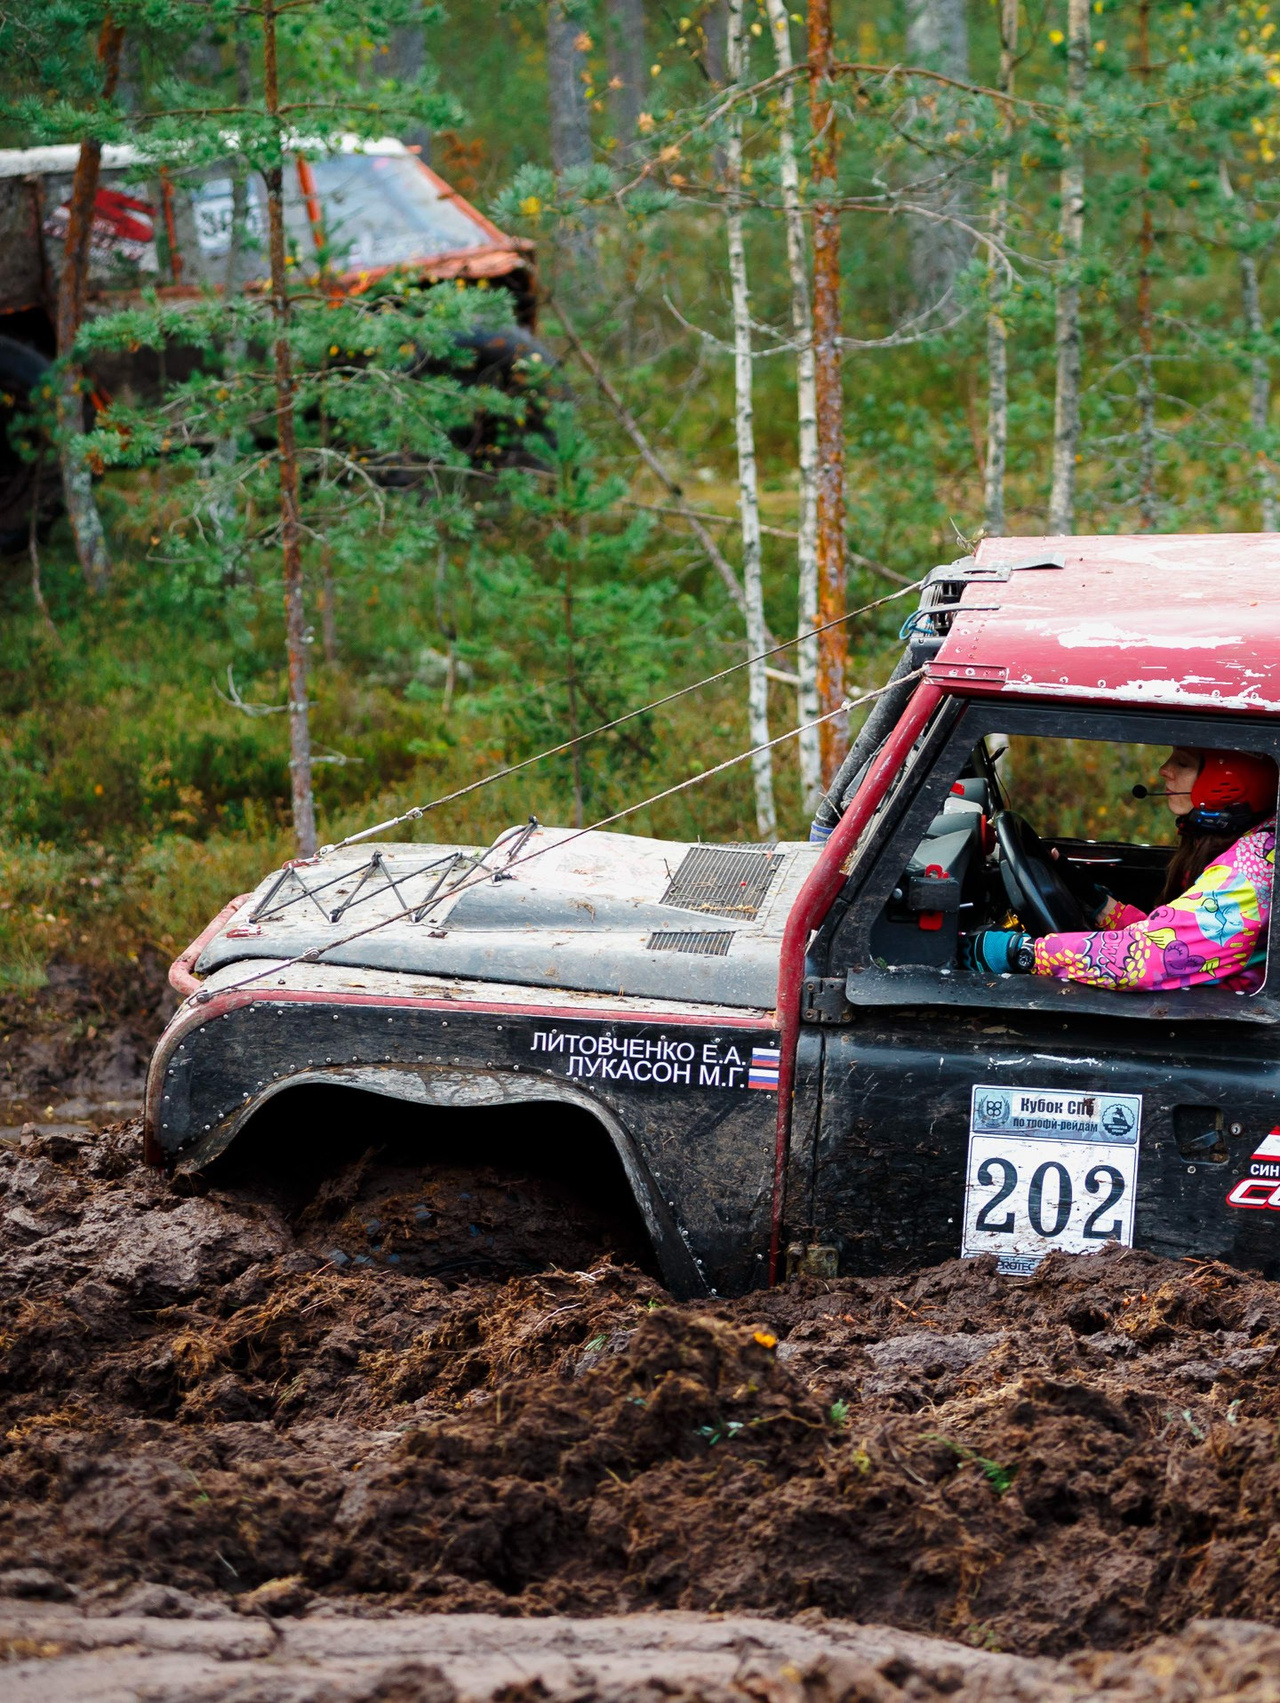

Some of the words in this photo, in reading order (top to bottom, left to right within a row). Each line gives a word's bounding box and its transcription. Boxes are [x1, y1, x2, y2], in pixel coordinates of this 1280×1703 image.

[530, 1033, 695, 1061] ЛИТОВЧЕНКО
[702, 1044, 747, 1066] Е.А.
[566, 1055, 690, 1084] ЛУКАСОН
[699, 1066, 745, 1088] М.Г.
[1021, 1097, 1064, 1115] Кубок
[1012, 1118, 1025, 1127] по
[1027, 1118, 1098, 1133] трофи-рейдам
[976, 1157, 1125, 1241] 202
